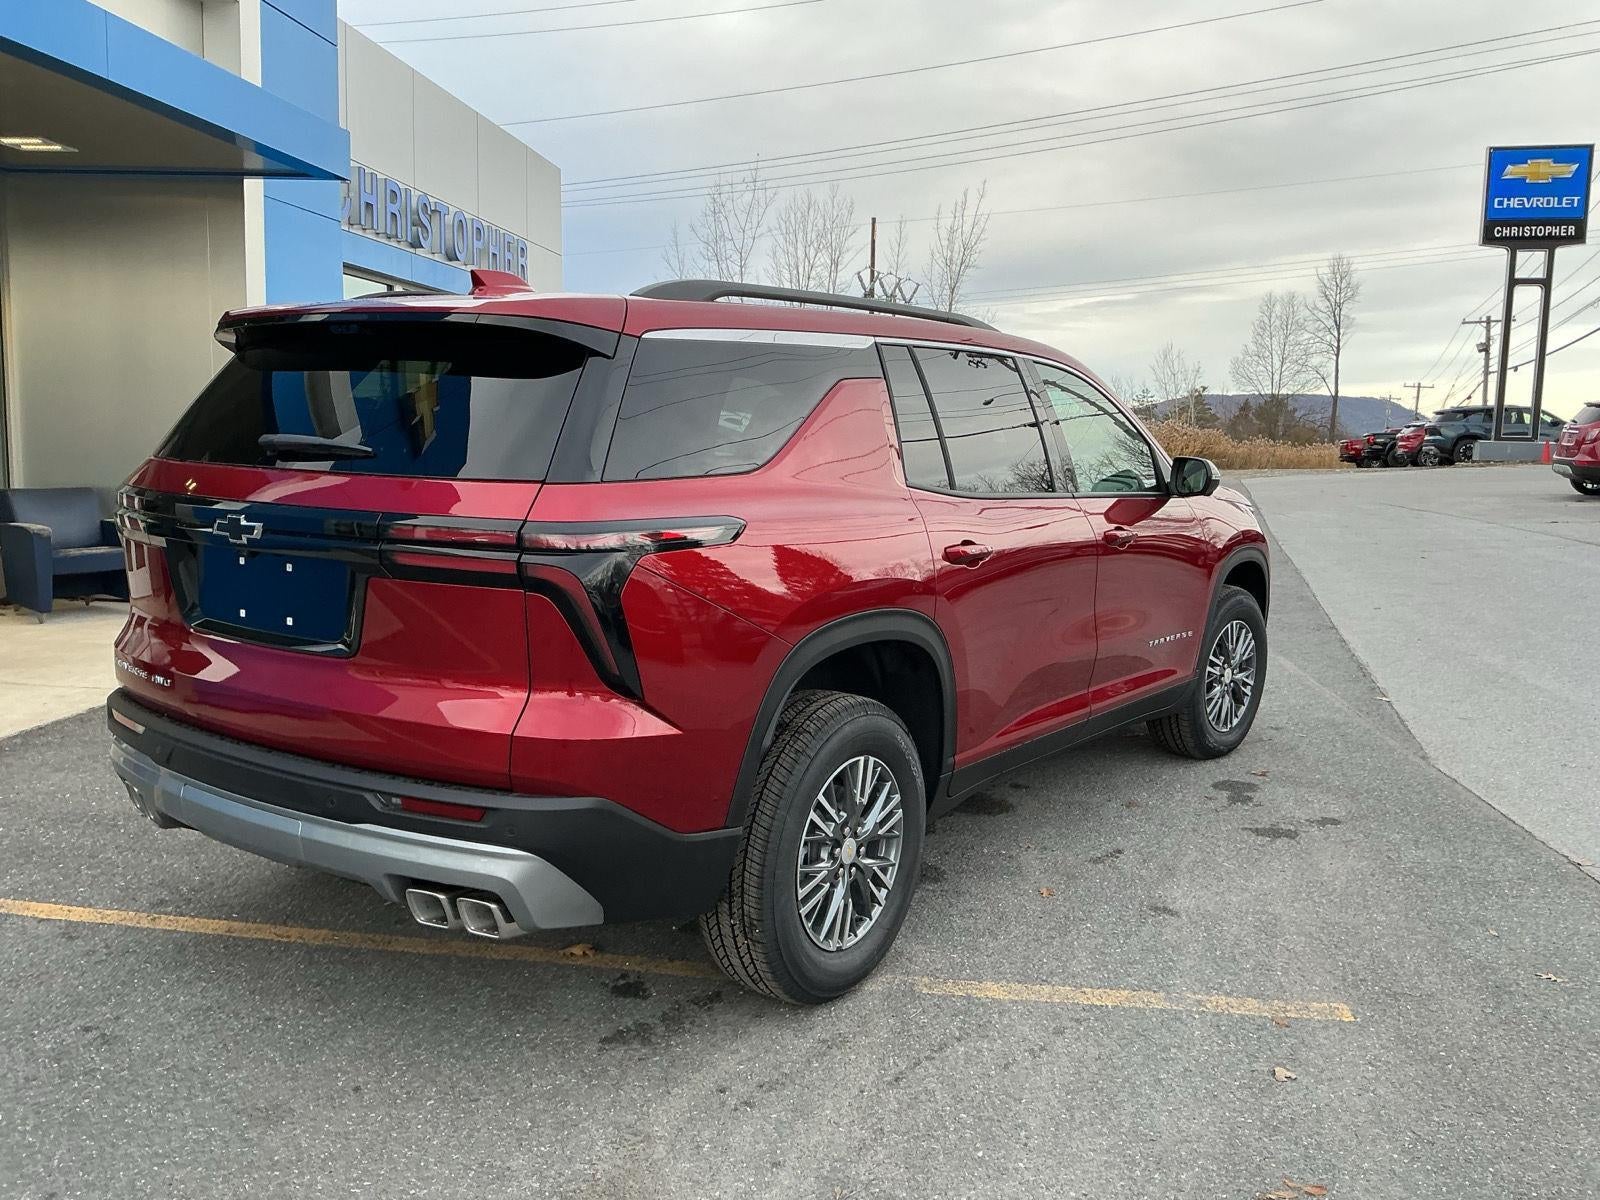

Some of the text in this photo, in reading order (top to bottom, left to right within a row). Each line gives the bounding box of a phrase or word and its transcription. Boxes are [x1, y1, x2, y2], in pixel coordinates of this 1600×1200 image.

[1494, 197, 1581, 208] CHEVROLET
[1494, 225, 1575, 237] CHRISTOPHER
[1149, 630, 1193, 648] TRAVERSE
